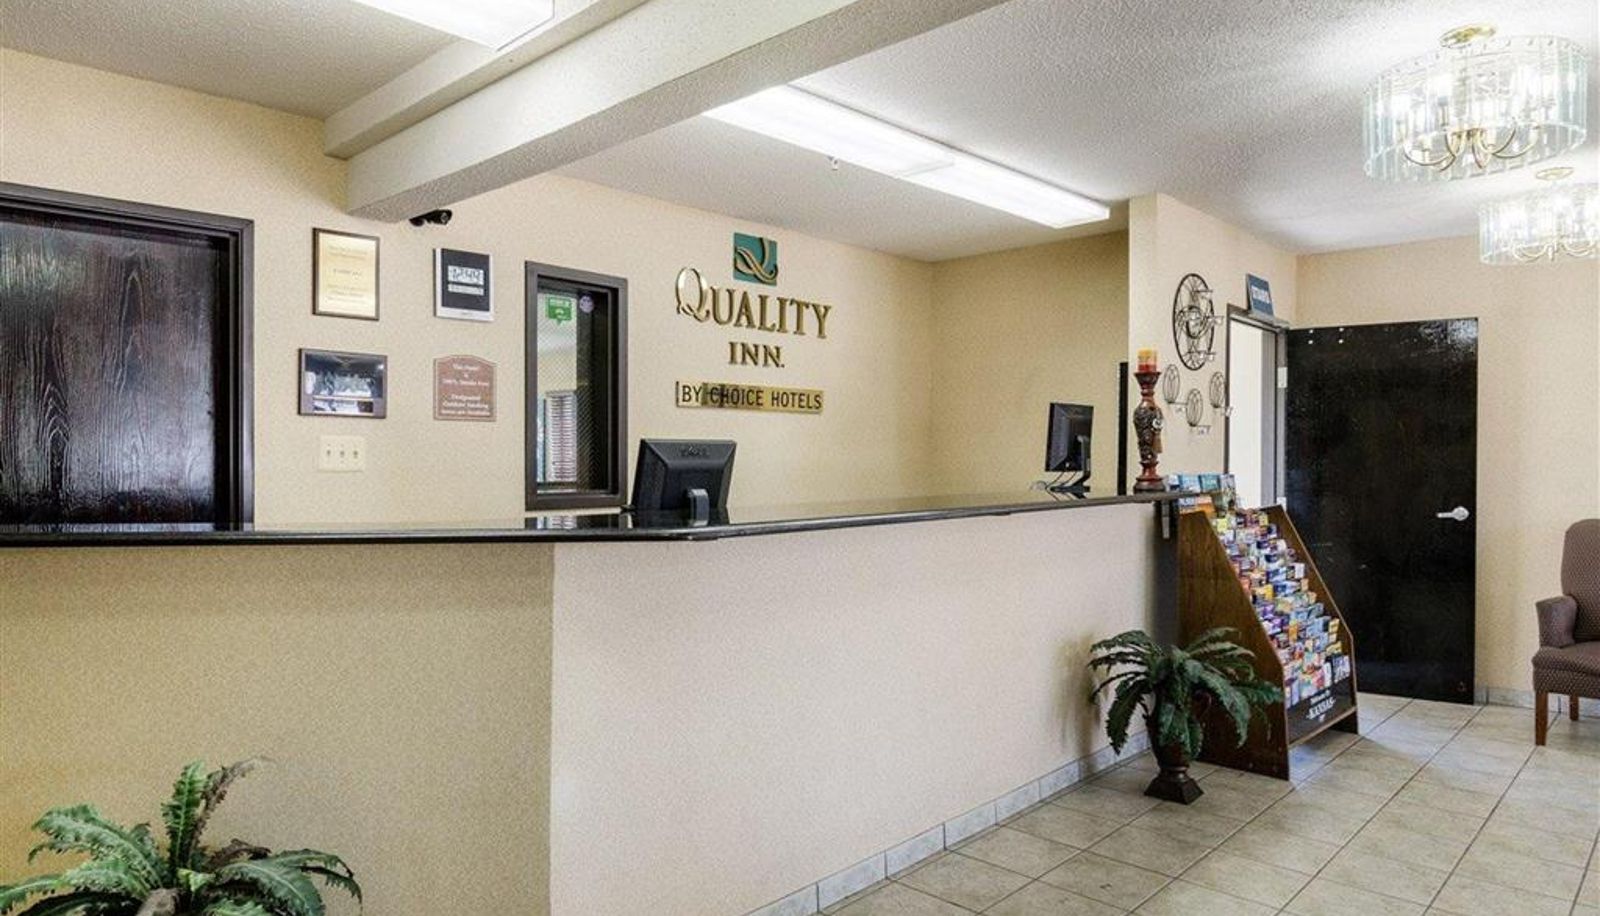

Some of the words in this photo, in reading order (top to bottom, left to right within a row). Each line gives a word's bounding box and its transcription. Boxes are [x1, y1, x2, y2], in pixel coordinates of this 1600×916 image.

[675, 267, 832, 339] QUALITY
[682, 385, 702, 403] BY
[710, 386, 764, 407] CHOICE
[771, 391, 822, 410] HOTELS
